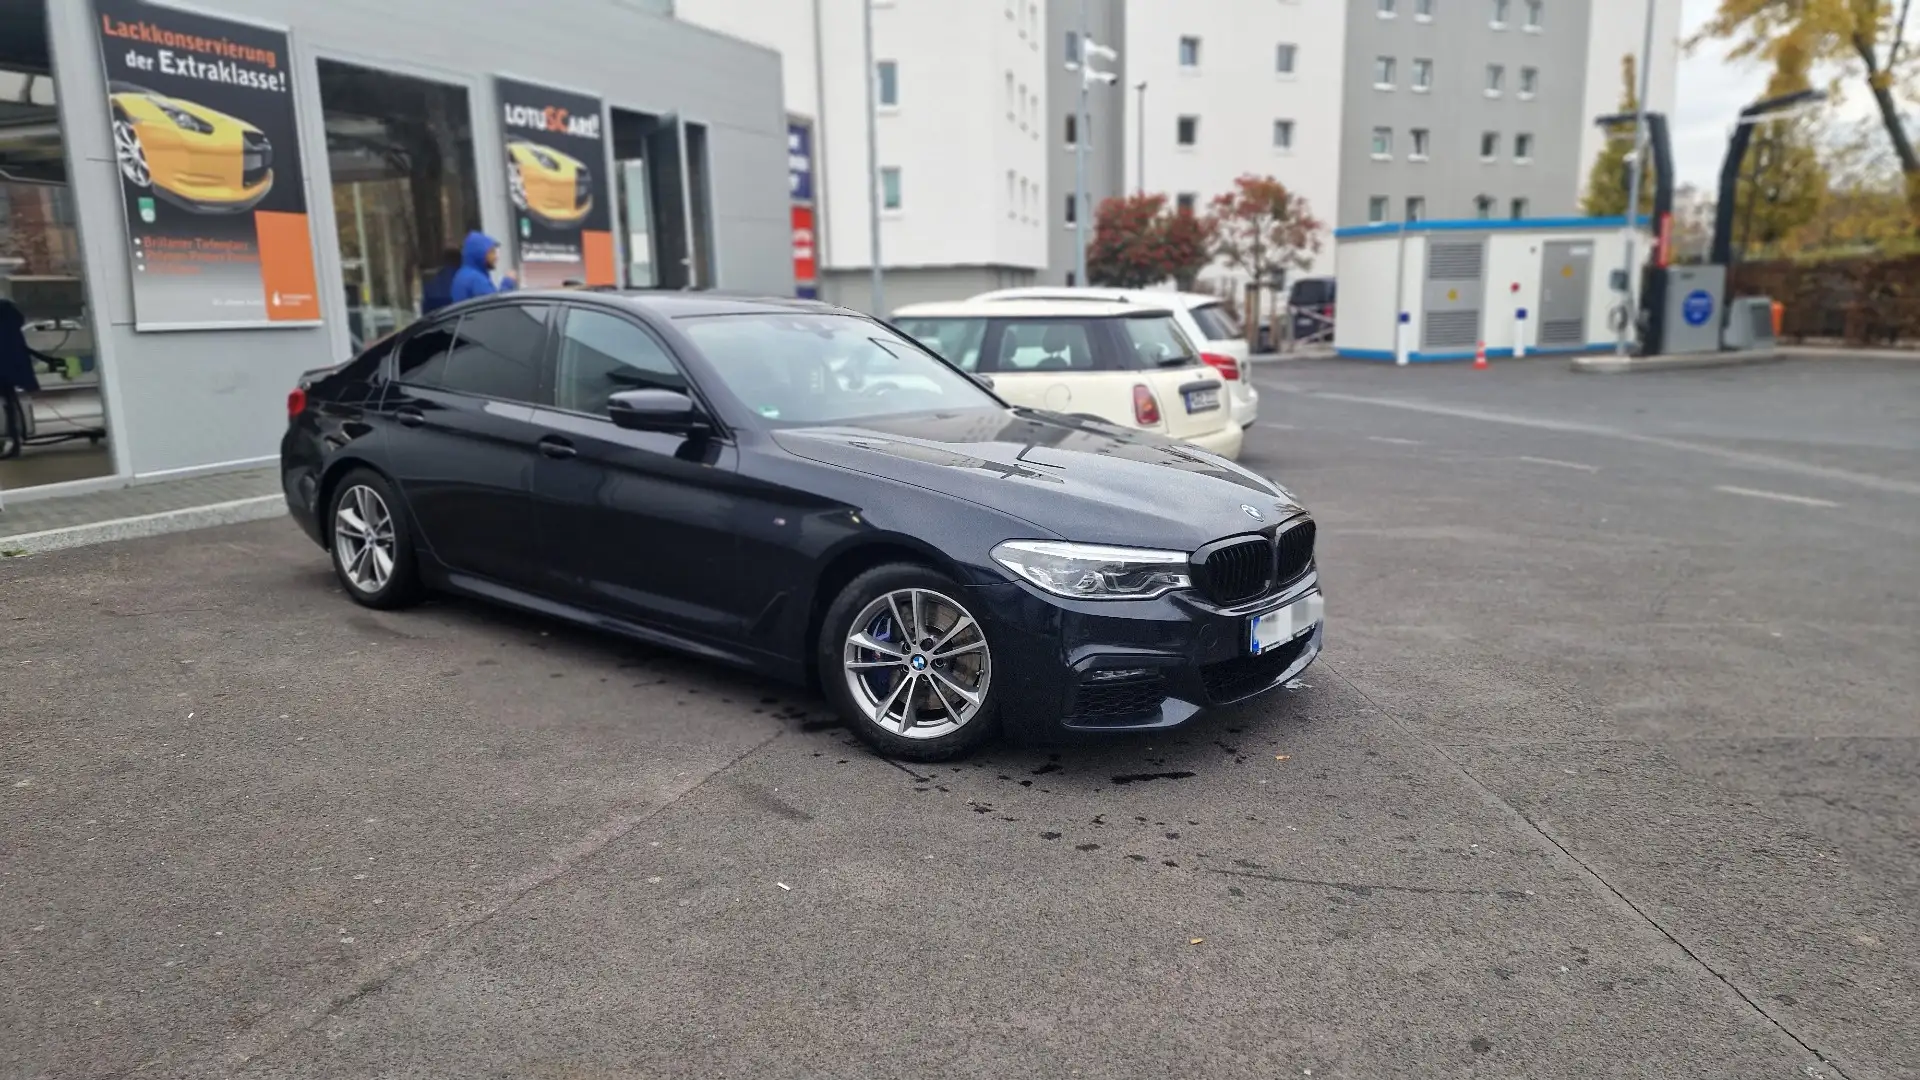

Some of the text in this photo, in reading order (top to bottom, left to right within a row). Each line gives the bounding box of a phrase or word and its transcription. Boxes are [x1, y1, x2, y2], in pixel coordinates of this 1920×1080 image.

[102, 14, 277, 68] Lackkonservierung
[125, 50, 287, 92] der Extraklasse!
